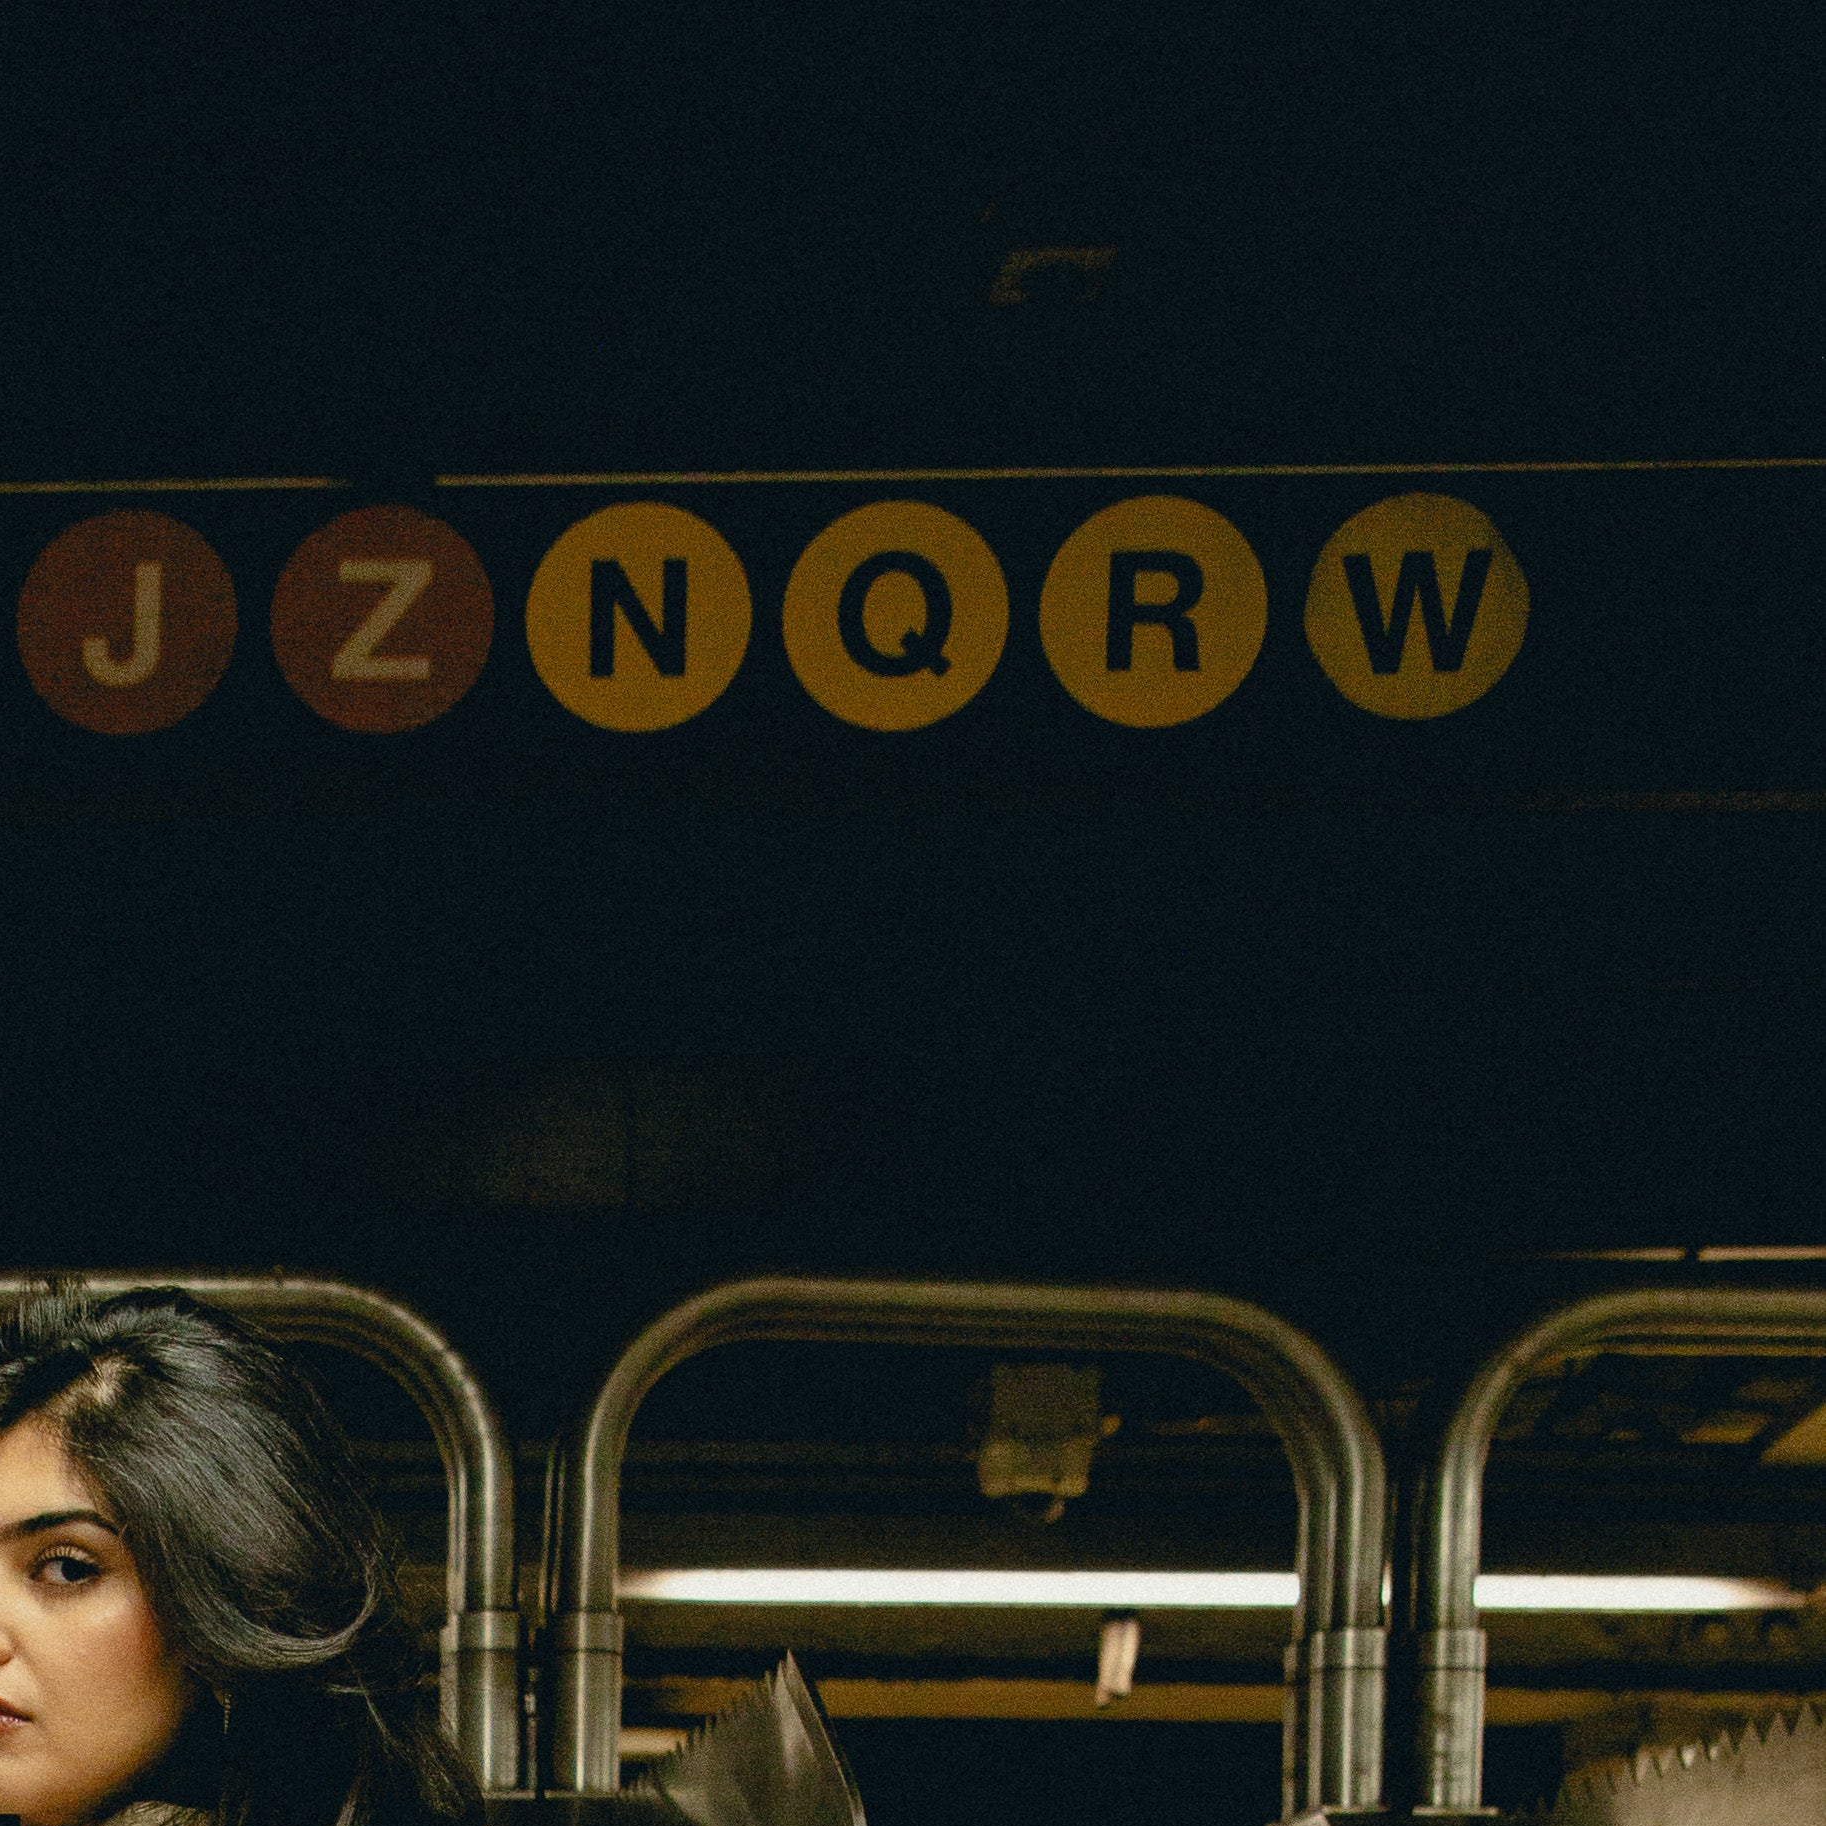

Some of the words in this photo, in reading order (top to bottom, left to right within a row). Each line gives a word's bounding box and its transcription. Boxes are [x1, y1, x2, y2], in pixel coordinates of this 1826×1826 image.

[82, 564, 163, 685] J
[331, 560, 432, 680] Z
[588, 556, 690, 680] N
[836, 549, 954, 679] Q
[1104, 547, 1207, 674] R
[1342, 548, 1493, 676] W
